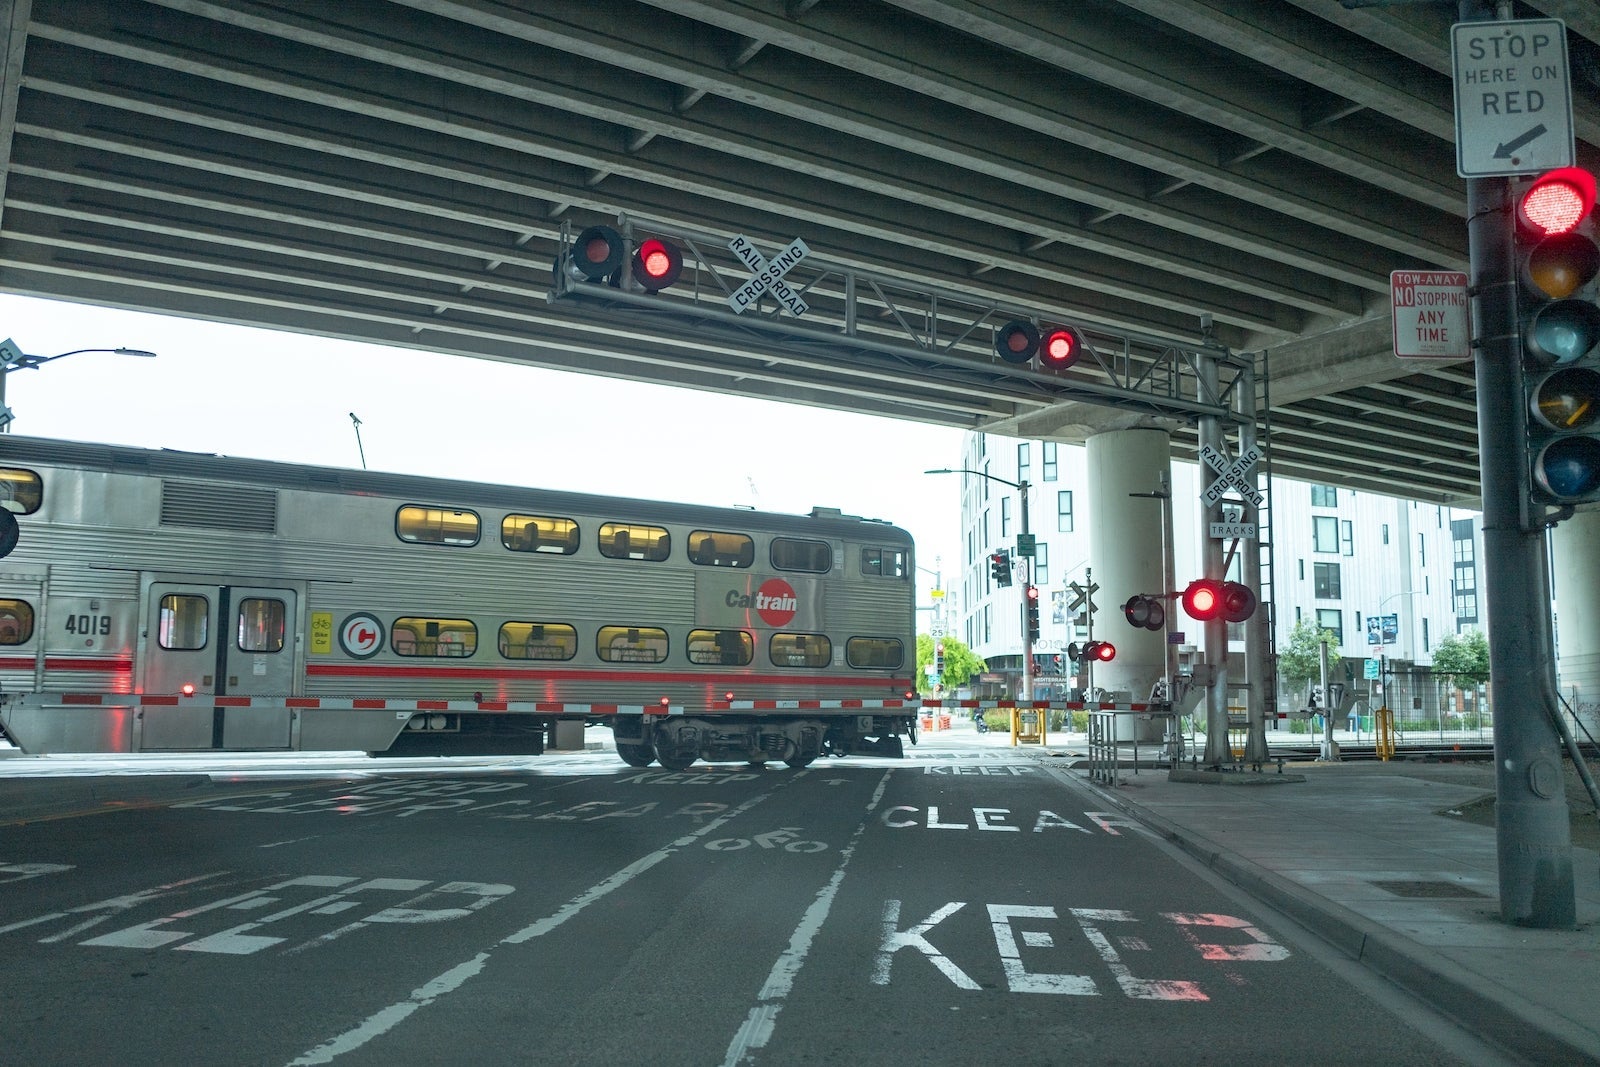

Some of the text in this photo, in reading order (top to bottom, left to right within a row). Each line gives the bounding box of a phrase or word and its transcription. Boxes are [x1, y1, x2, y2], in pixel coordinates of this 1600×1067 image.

[1469, 34, 1549, 60] STOP
[1465, 65, 1557, 84] HERE ON
[1482, 90, 1545, 115] RED
[732, 237, 806, 316] RAIL ROAD
[735, 246, 803, 306] CROSSING
[1397, 274, 1459, 284] TOW-AWAY
[1395, 287, 1465, 307] NO STOPPING
[1417, 310, 1446, 325] ANY
[1416, 327, 1449, 342] TIME
[1201, 446, 1263, 507] RAIL ROAD
[1206, 450, 1258, 501] CROSSING
[1229, 512, 1237, 523] 2
[1212, 526, 1254, 535] TRACKS
[725, 589, 797, 611] Caltrain
[65, 614, 112, 636] 4019
[931, 629, 944, 637] 25
[615, 773, 760, 785] KEEP
[922, 766, 1035, 776] KEEP
[870, 900, 1291, 1002] KEEP
